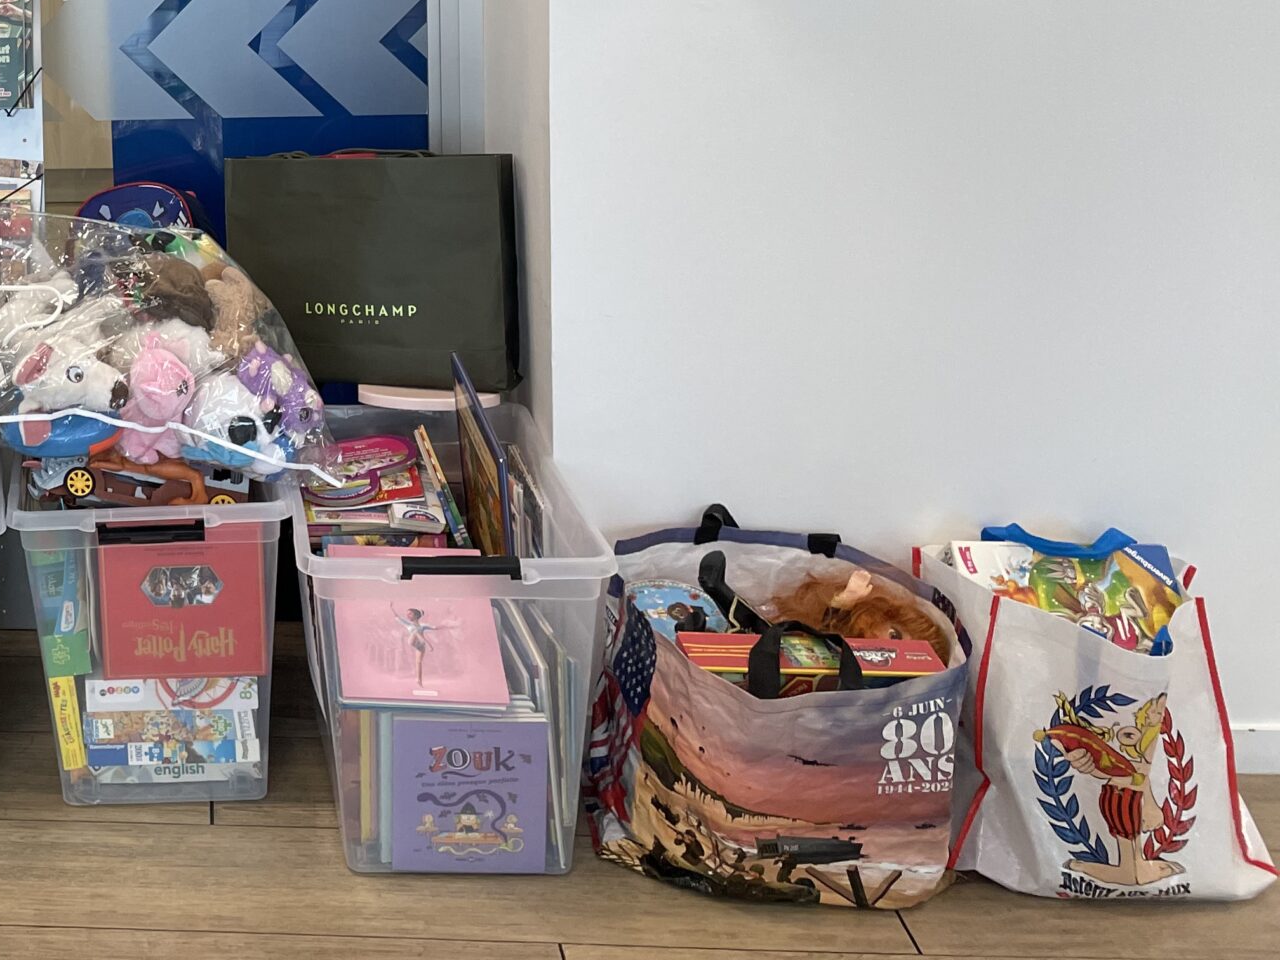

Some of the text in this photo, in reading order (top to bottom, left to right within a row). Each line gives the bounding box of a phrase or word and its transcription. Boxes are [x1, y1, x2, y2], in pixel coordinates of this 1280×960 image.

[305, 302, 417, 317] LONGCHAMP
[1123, 547, 1173, 586] Ravensburger
[134, 621, 238, 662] Harry Potter
[909, 697, 945, 716] JUIN
[880, 712, 954, 759] 80
[154, 764, 205, 779] english
[878, 754, 955, 784] ANS
